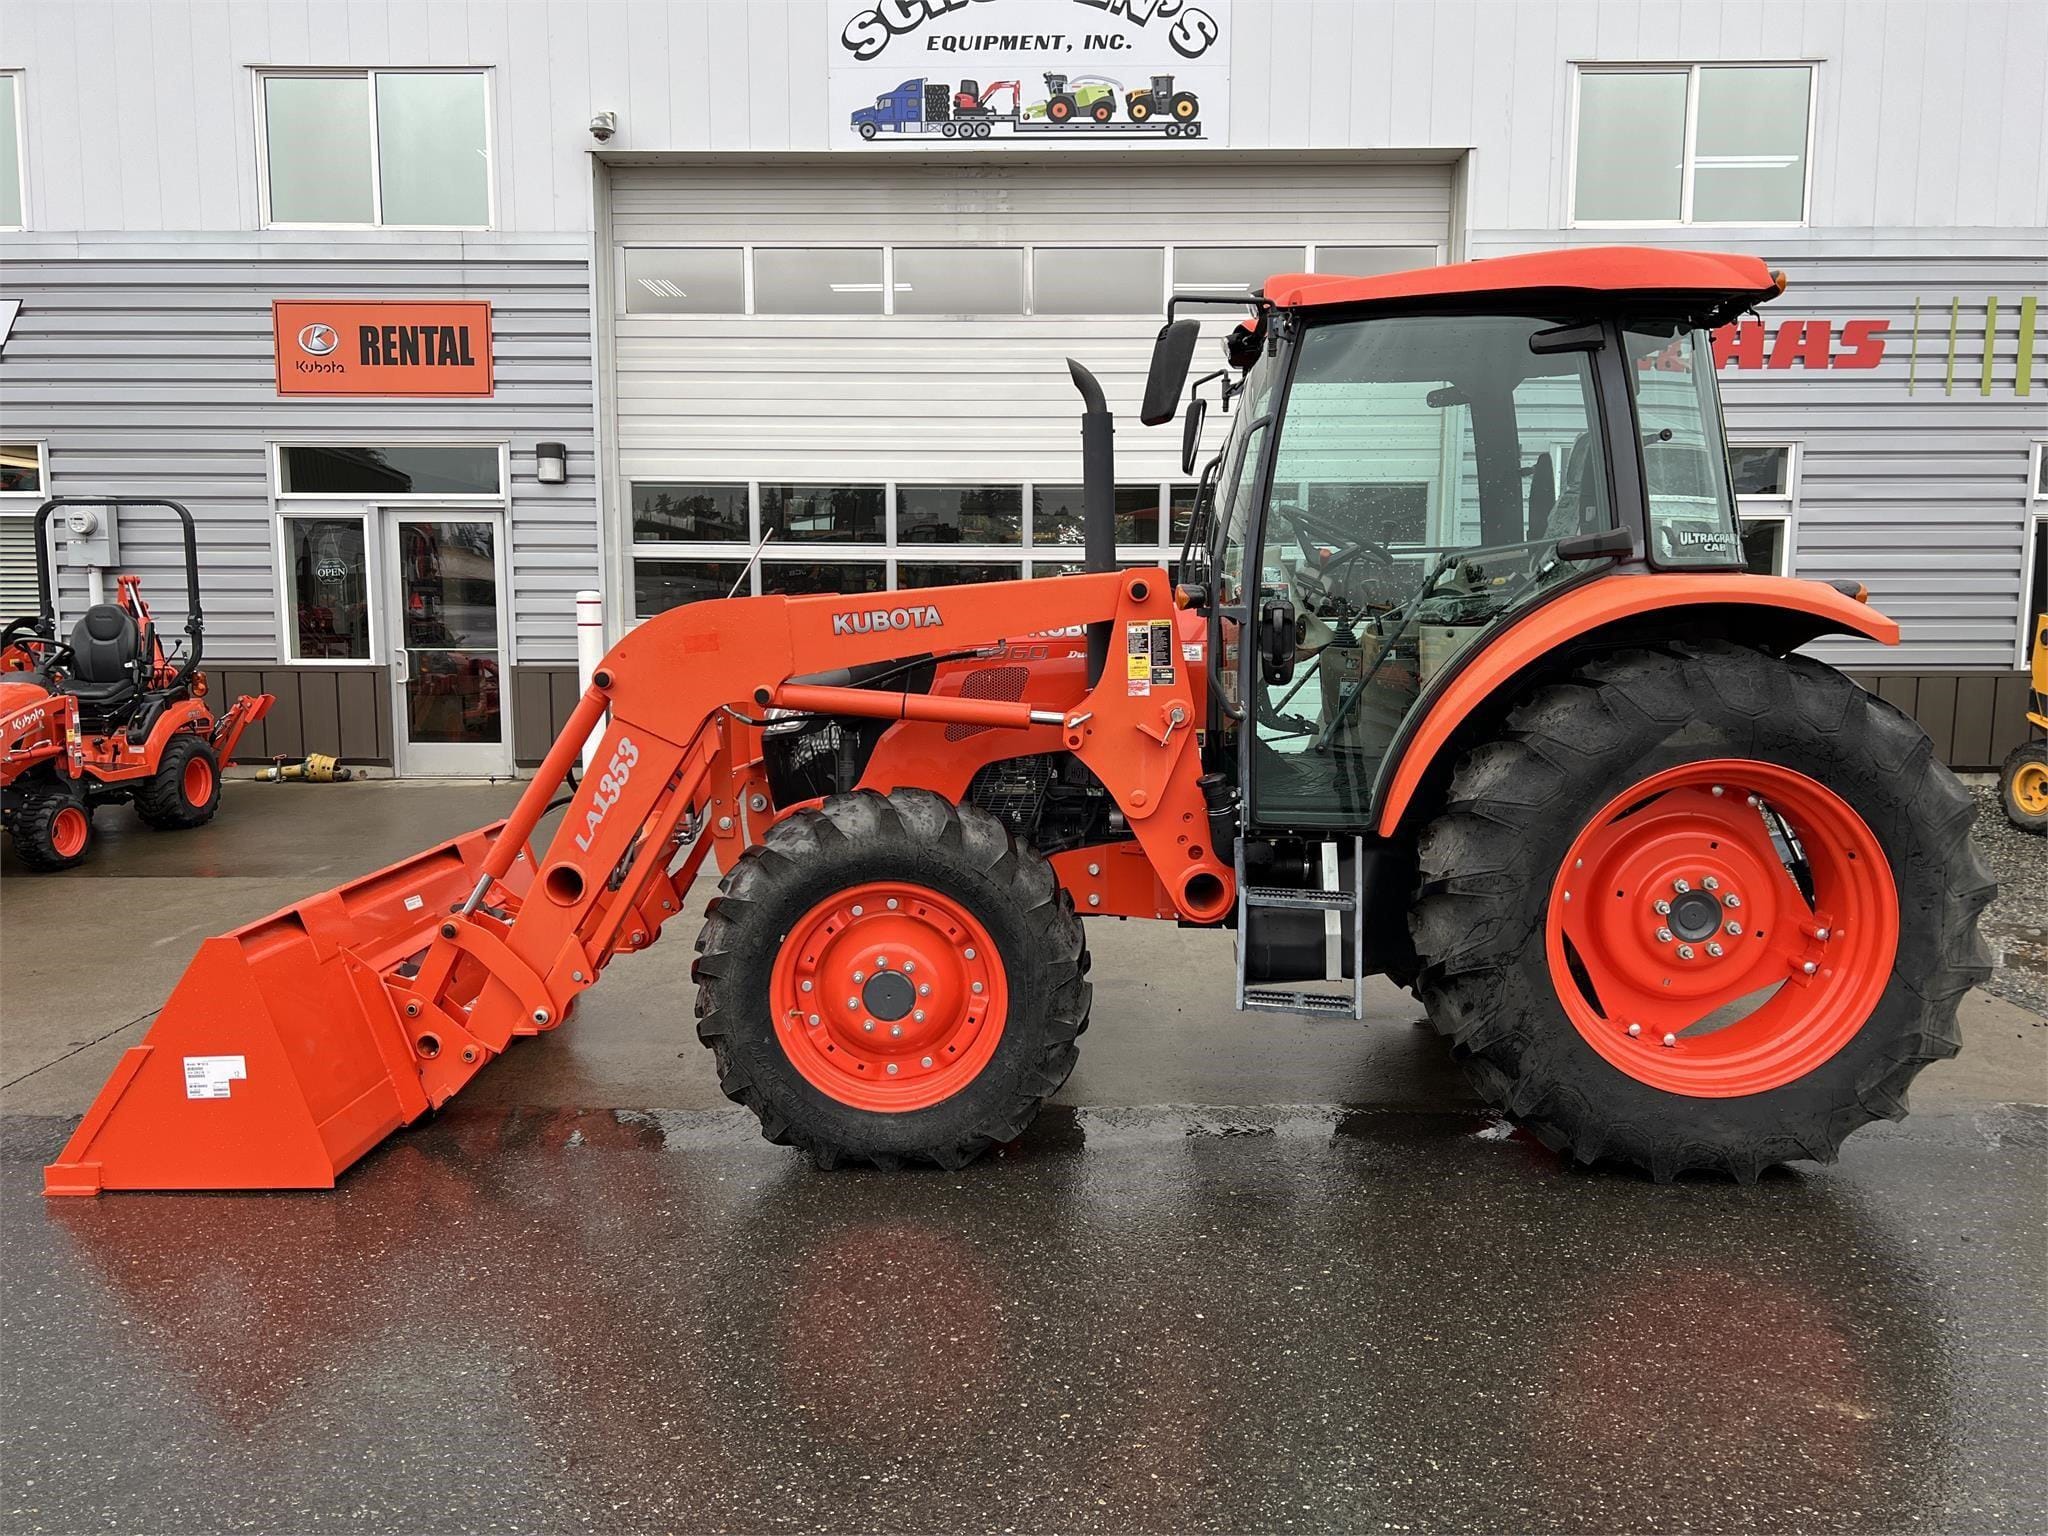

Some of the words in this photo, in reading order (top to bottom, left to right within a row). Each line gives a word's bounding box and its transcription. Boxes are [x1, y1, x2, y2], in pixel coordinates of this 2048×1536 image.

[926, 34, 1073, 53] EQUIPMENT,
[1083, 34, 1133, 51] INC.
[359, 325, 475, 366] RENTAL
[296, 360, 345, 374] Kubota
[1703, 543, 1727, 552] CAB
[317, 567, 346, 577] OPEN
[832, 605, 944, 635] KUBOTA
[11, 707, 45, 731] Kubota
[575, 737, 639, 852] LA1353
